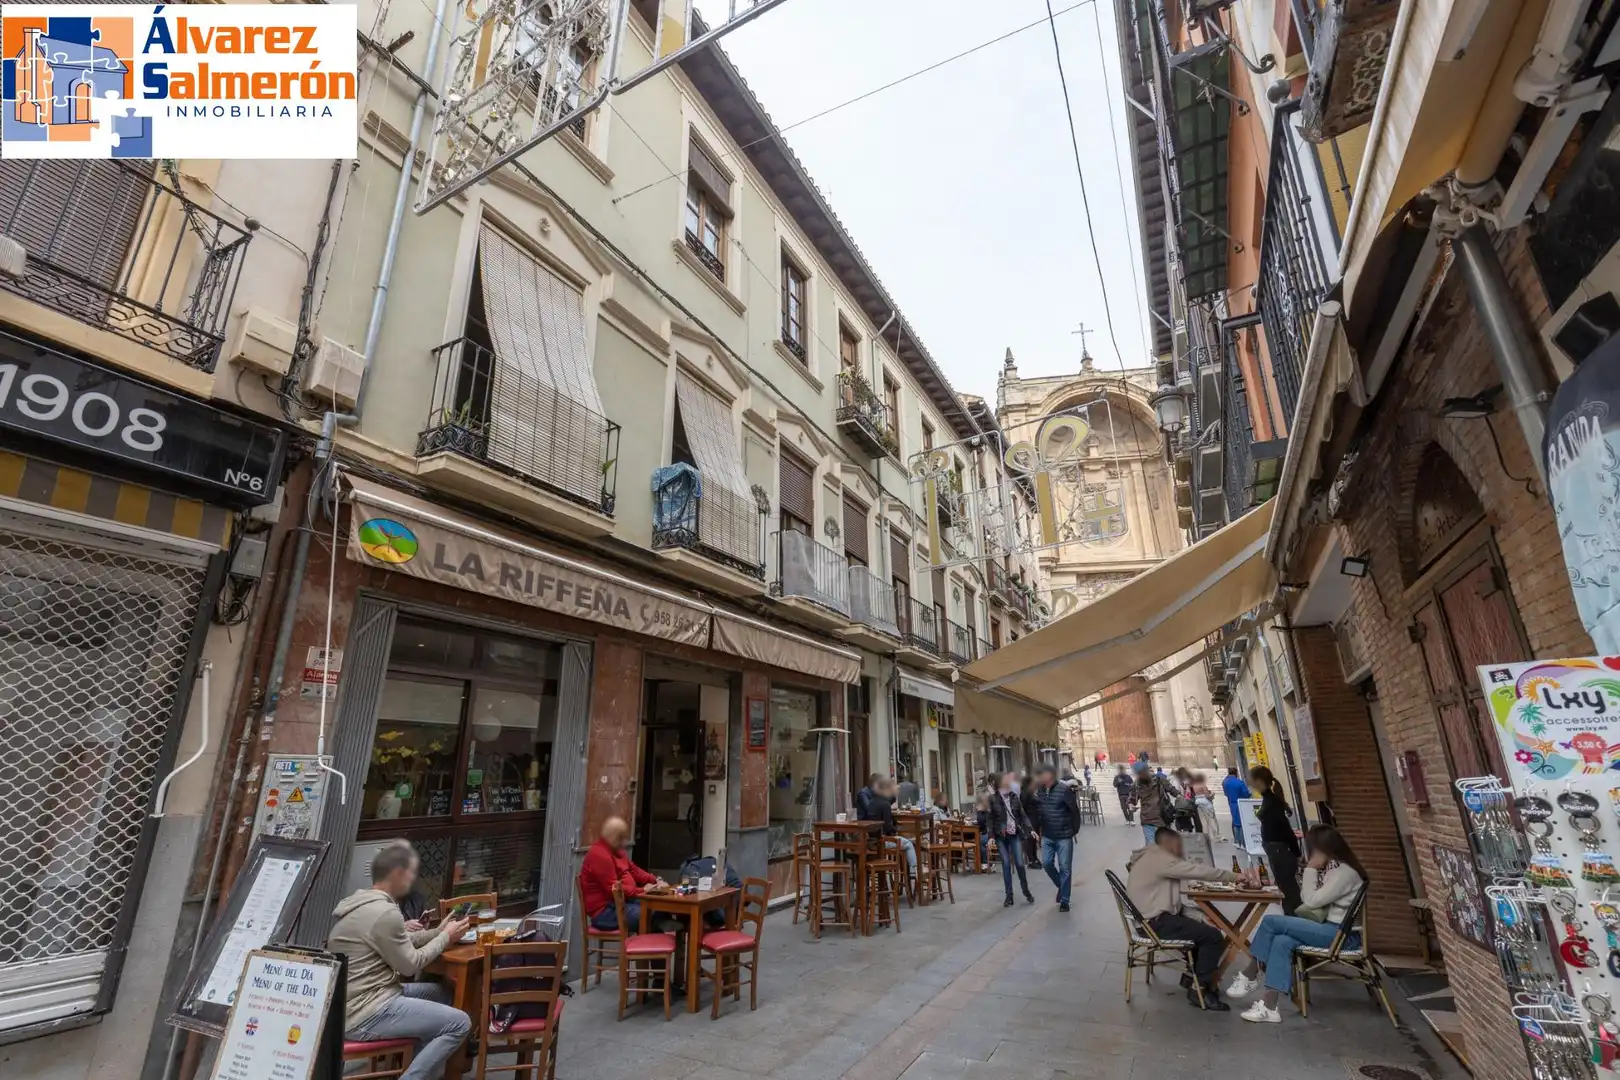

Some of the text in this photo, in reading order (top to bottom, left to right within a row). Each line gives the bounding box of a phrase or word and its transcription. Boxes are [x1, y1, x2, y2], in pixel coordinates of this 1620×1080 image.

[0, 363, 167, 451] 1908
[433, 542, 485, 581] LA
[500, 562, 631, 620] RIFFEÑA
